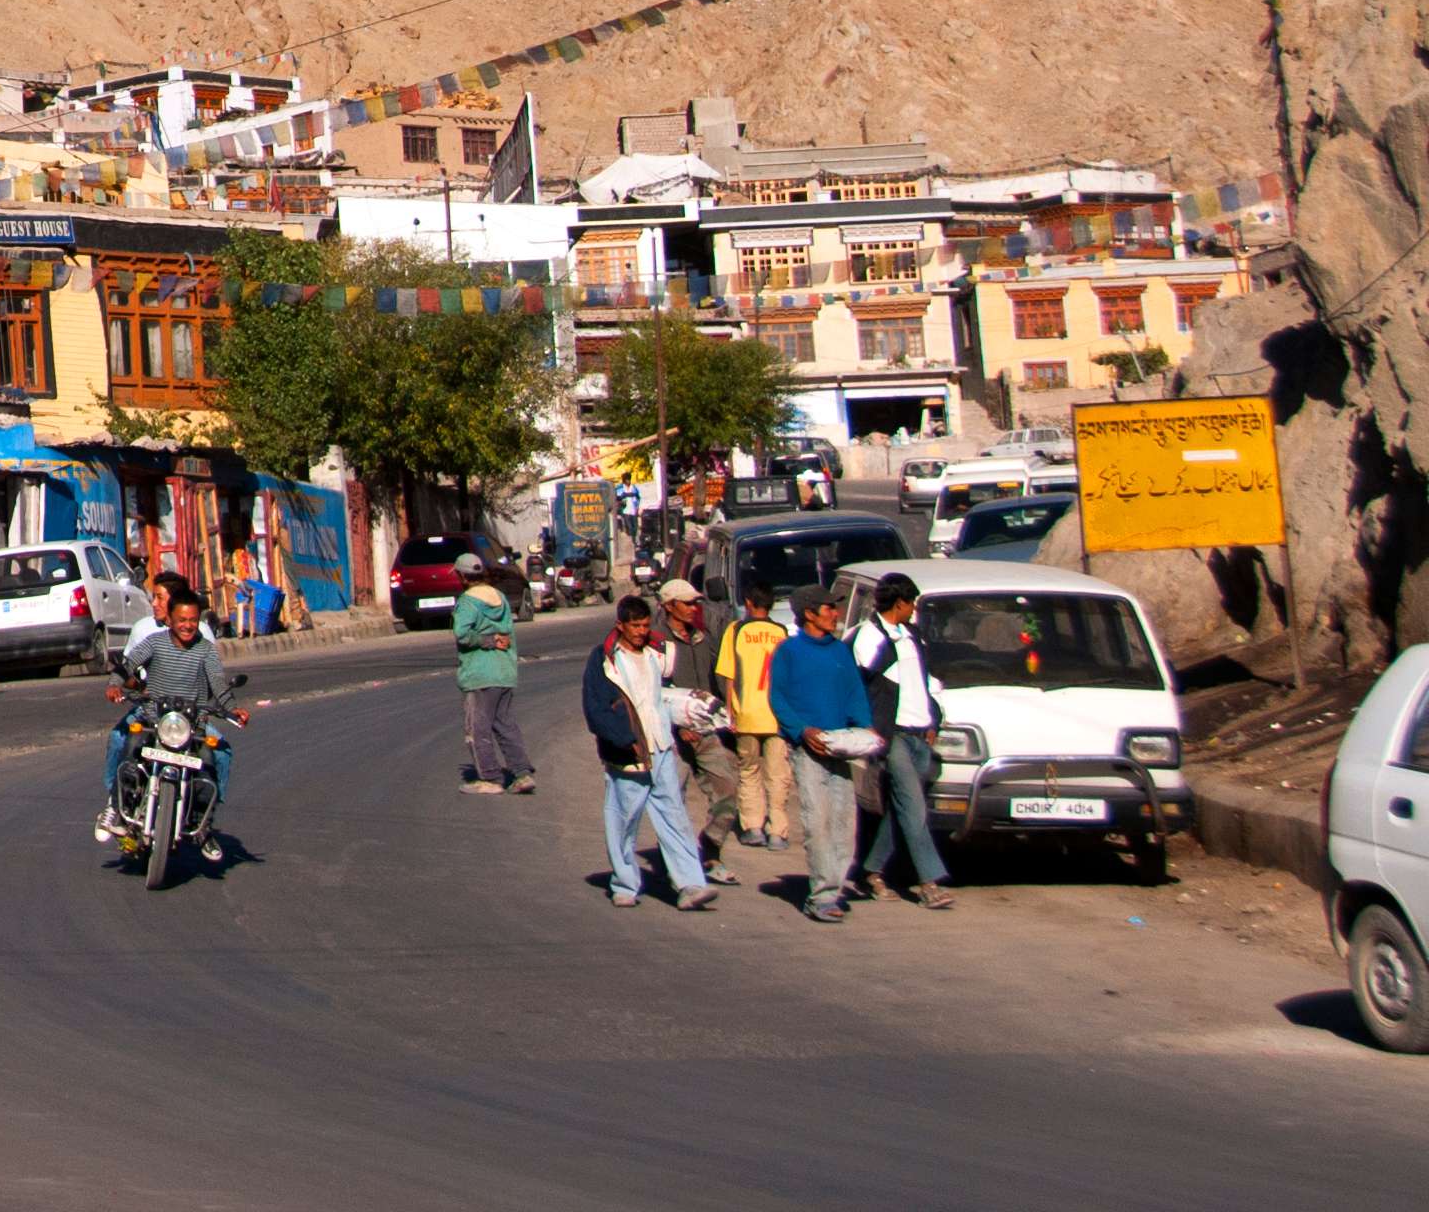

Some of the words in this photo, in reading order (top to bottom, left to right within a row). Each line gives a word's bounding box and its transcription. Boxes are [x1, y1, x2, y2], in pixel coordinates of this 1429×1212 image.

[33, 220, 70, 237] HOUSE
[571, 493, 602, 504] TATA
[81, 501, 116, 535] SOUND
[744, 631, 785, 645] buffo
